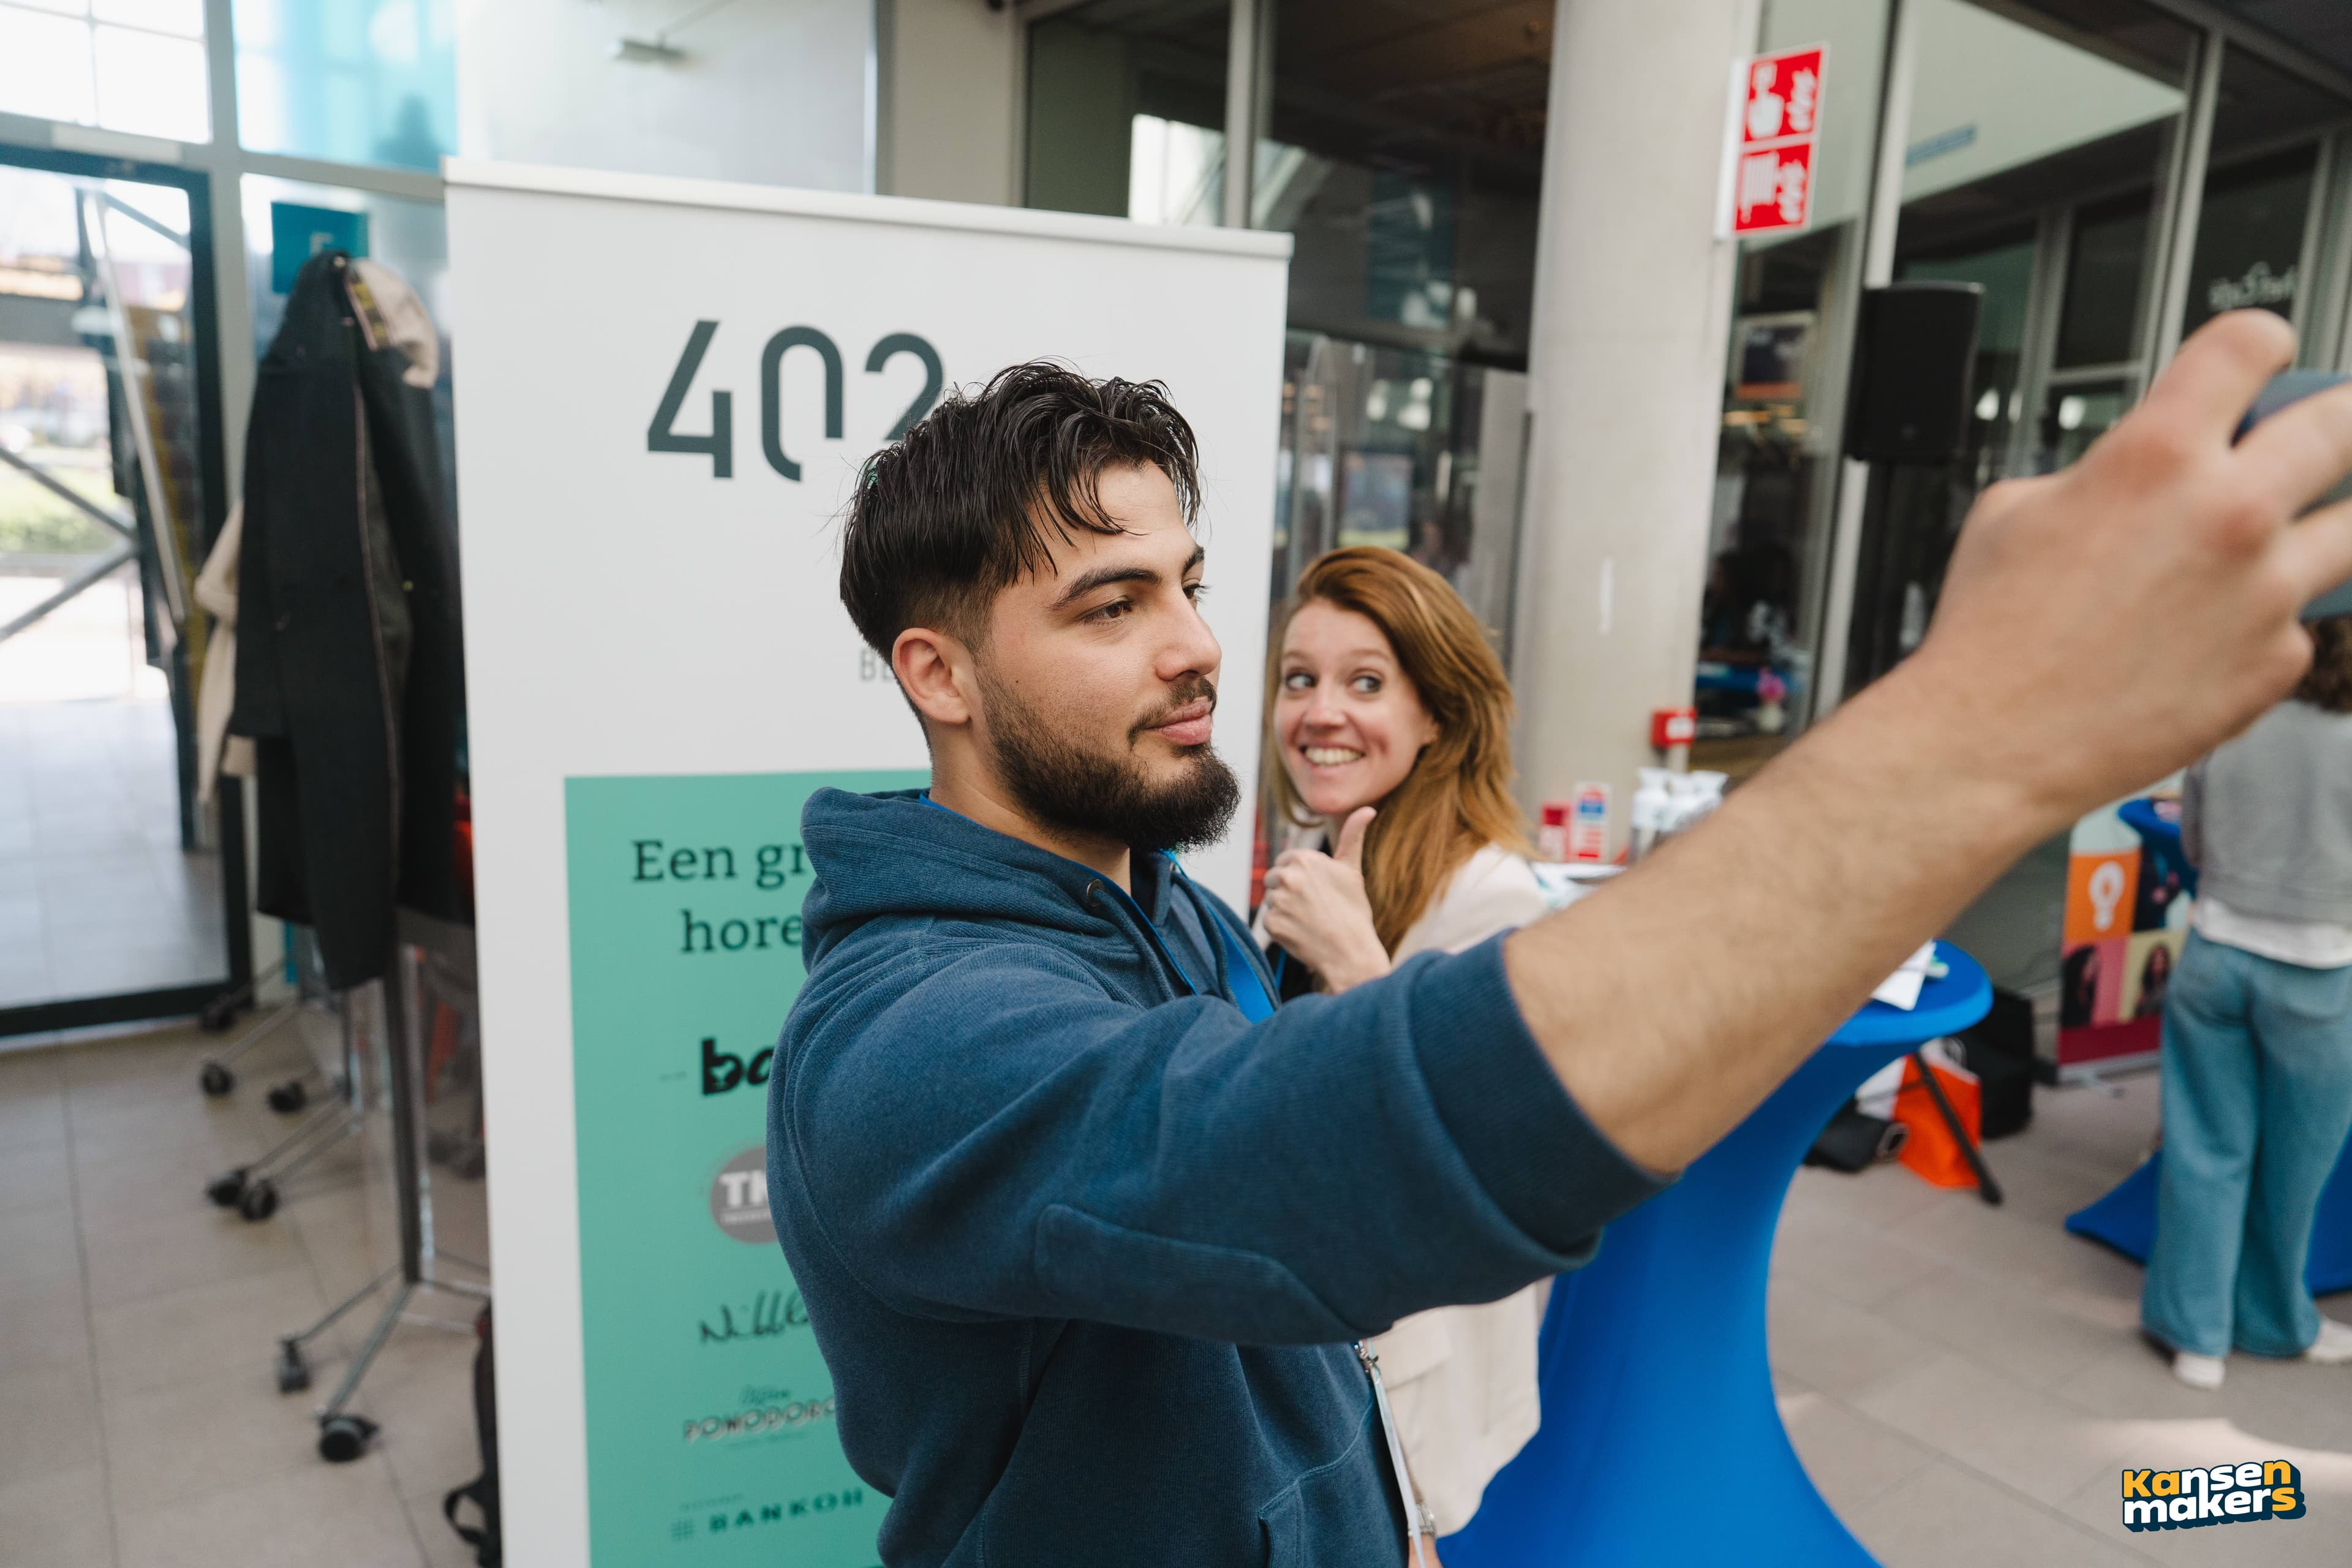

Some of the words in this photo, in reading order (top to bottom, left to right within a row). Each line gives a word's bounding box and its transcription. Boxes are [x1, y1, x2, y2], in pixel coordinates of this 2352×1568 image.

[647, 318, 944, 482] 402
[631, 838, 736, 882] Een
[681, 909, 802, 952] hore
